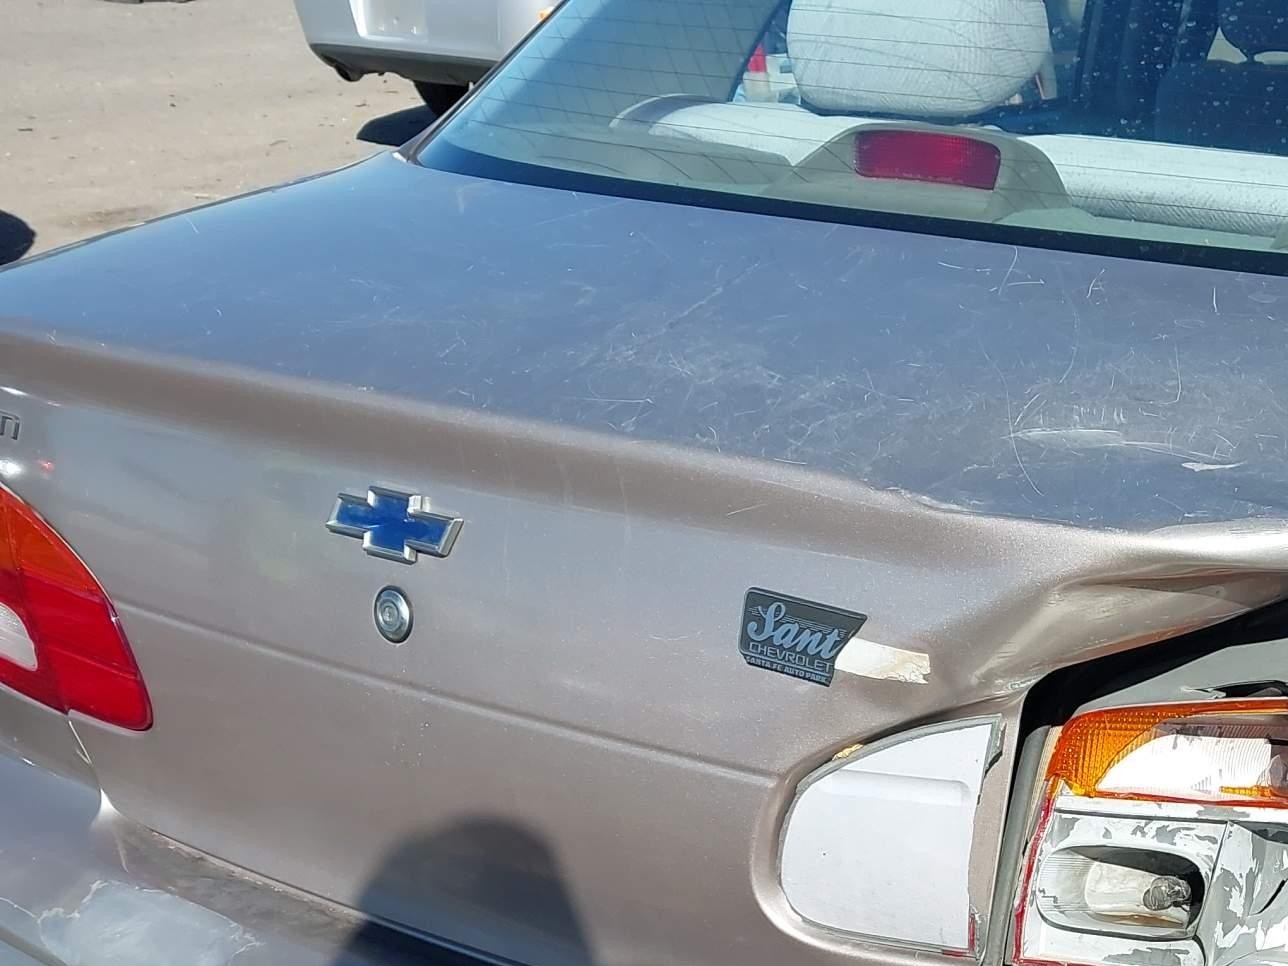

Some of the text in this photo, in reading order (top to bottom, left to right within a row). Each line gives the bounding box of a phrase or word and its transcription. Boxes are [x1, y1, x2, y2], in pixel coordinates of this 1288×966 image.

[747, 602, 842, 659] Sant
[746, 656, 828, 683] SANTA FE AUTO PARK
[749, 642, 831, 673] CHEVROLET
